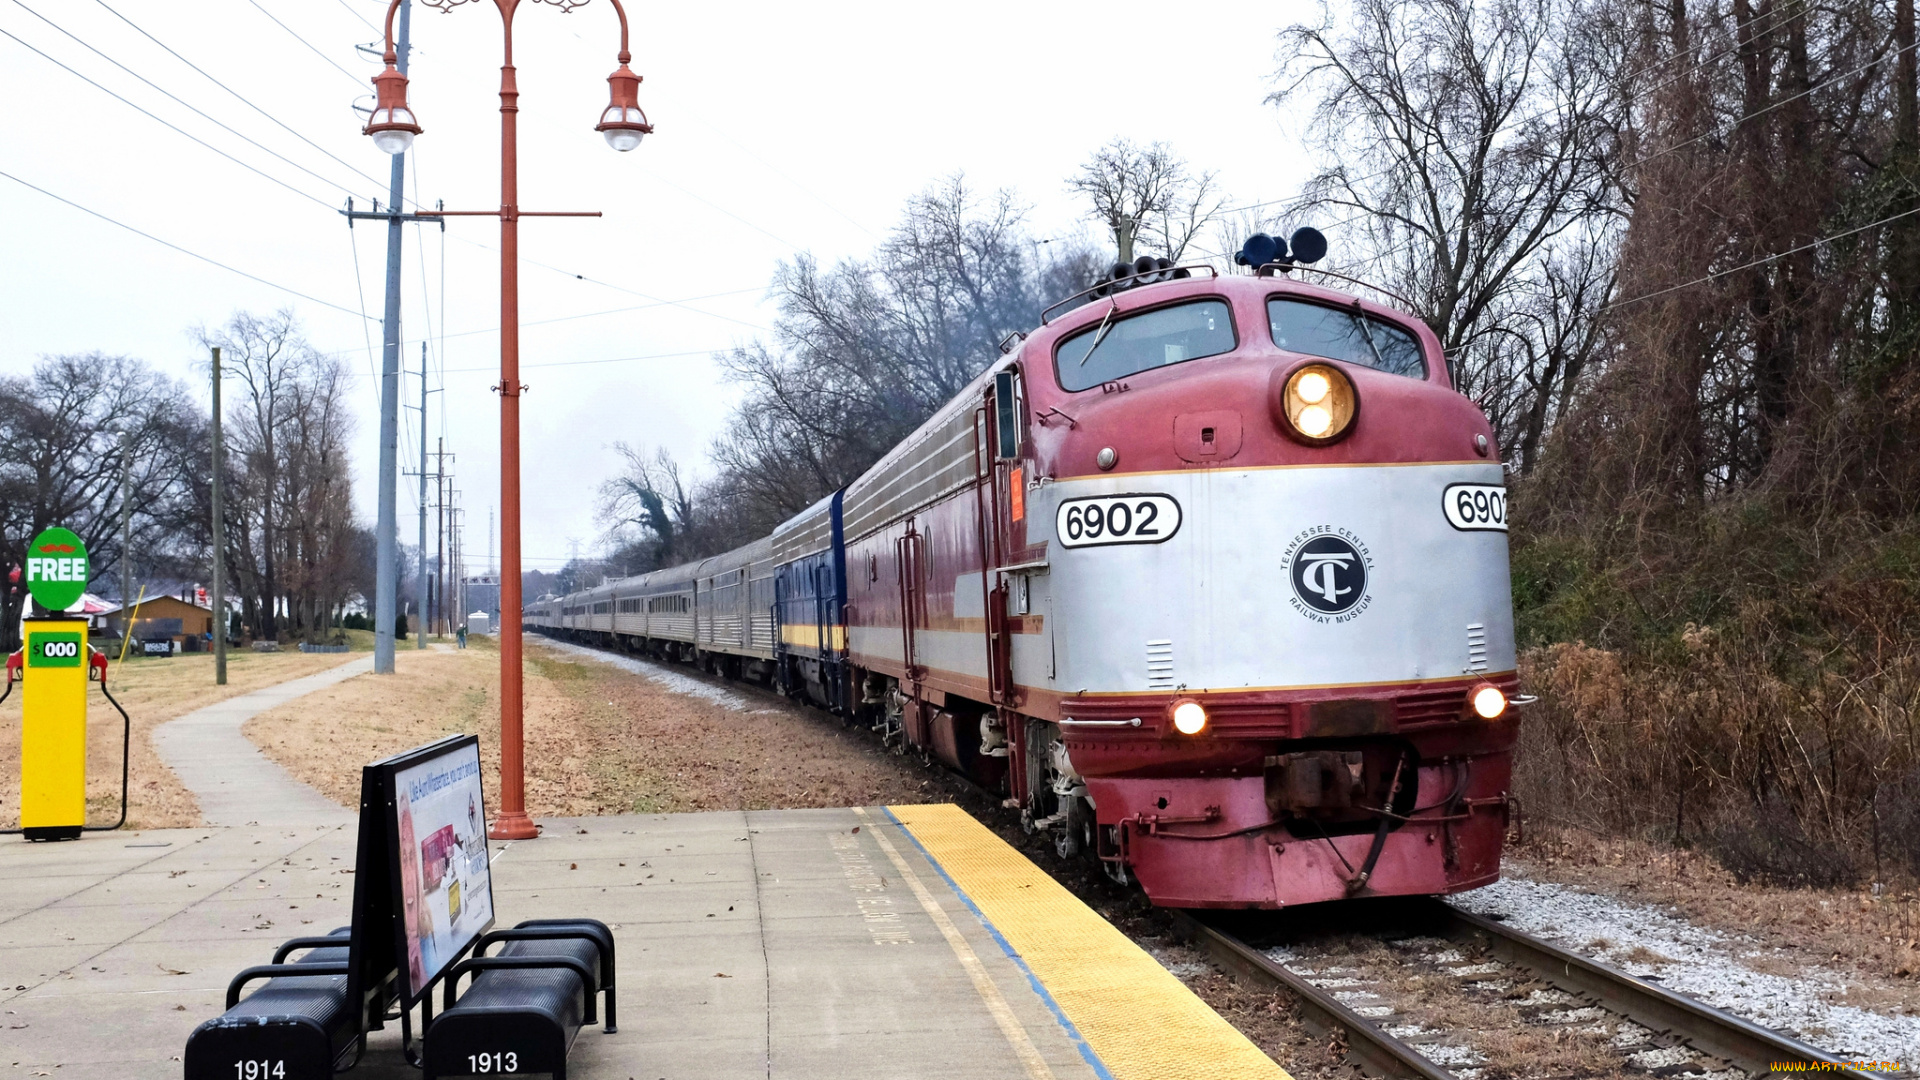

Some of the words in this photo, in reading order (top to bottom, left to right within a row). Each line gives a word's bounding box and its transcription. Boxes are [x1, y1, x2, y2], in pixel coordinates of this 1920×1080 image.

[1066, 501, 1159, 540] 6902
[1457, 489, 1508, 524] 690
[1280, 525, 1331, 570] TENNESSEE
[1338, 527, 1375, 571] CENTRAL
[27, 557, 86, 581] FREE
[1289, 597, 1331, 624] RAILWAY
[1335, 594, 1373, 624] MUSEUM
[234, 1059, 286, 1080] 1914
[468, 1051, 518, 1073] 1913
